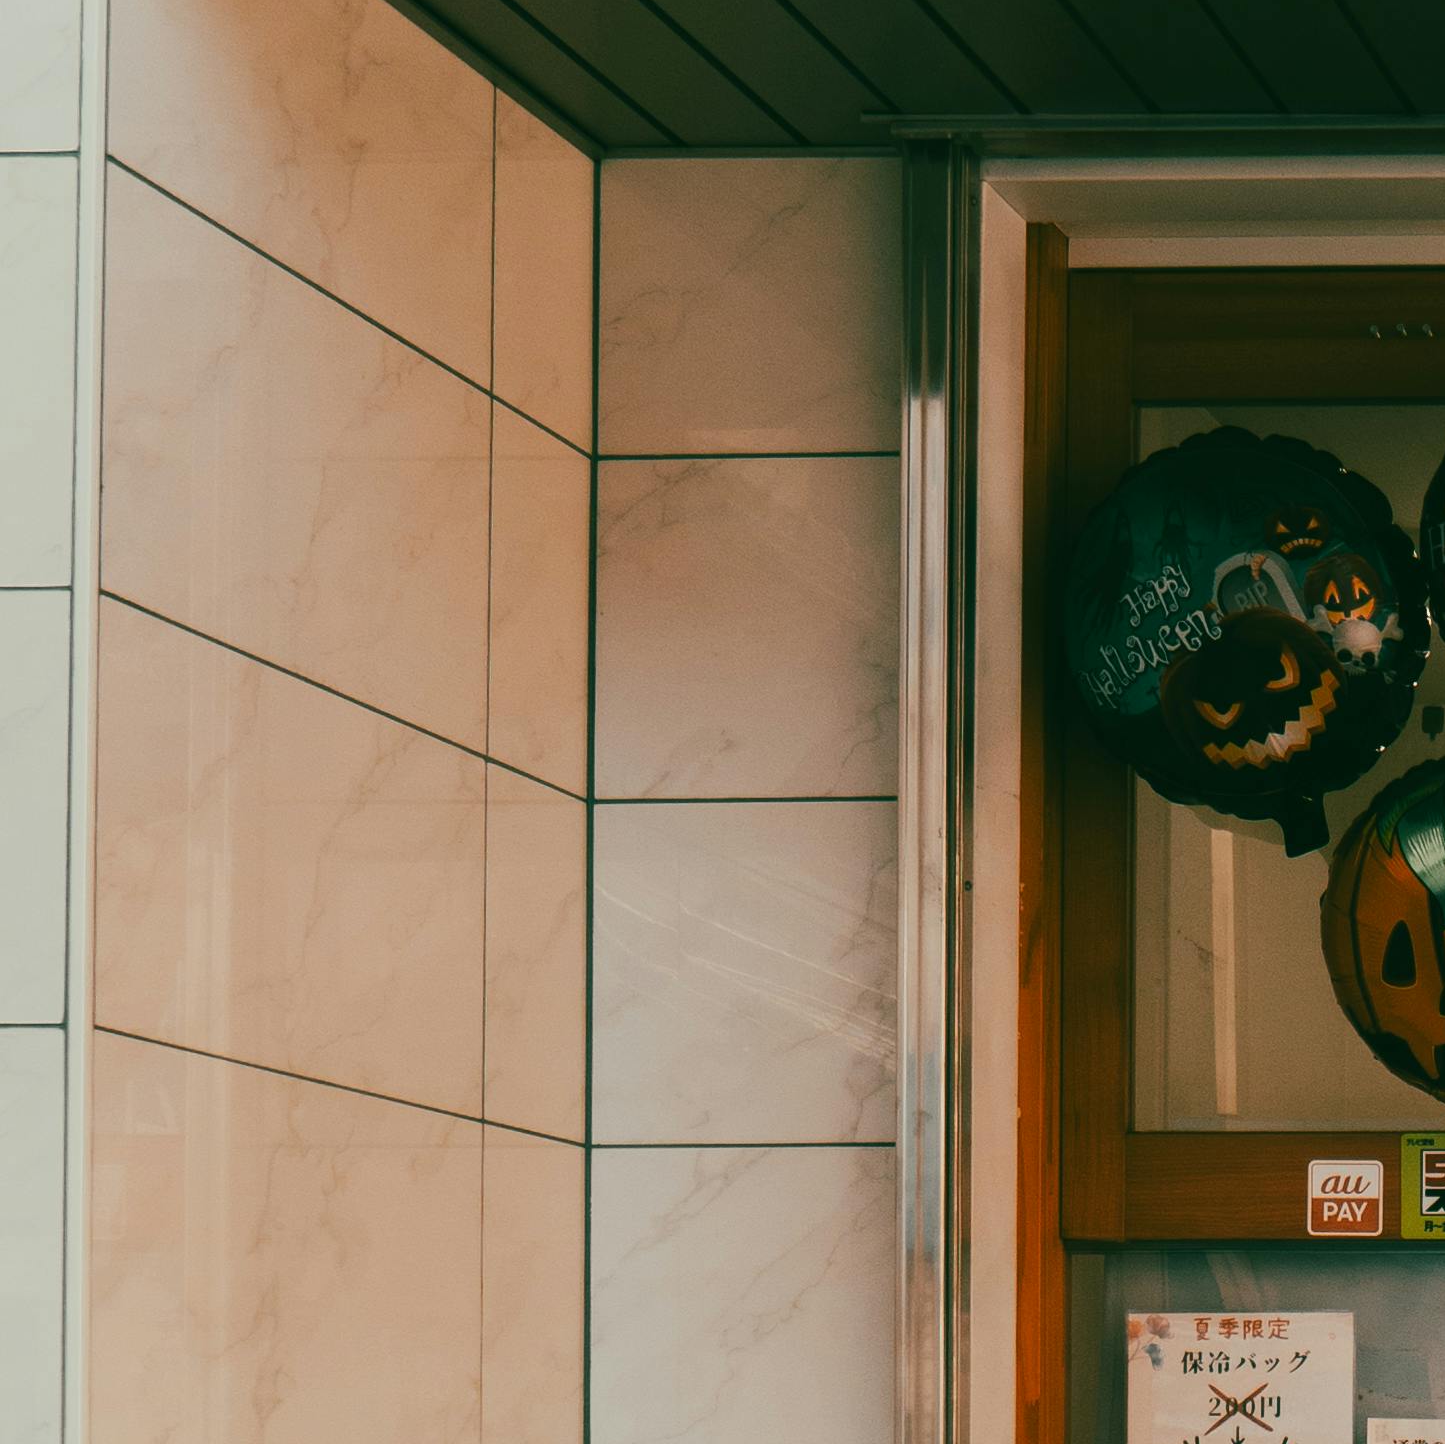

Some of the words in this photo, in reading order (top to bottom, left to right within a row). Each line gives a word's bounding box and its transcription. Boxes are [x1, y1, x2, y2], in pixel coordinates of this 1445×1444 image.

[1120, 564, 1191, 627] Happy
[1321, 1174, 1372, 1194] au
[1323, 1201, 1368, 1222] PAY
[1194, 1316, 1290, 1341] 夏季限定
[1181, 1350, 1311, 1374] 保冷バッグ
[1208, 1395, 1282, 1418] 200円
